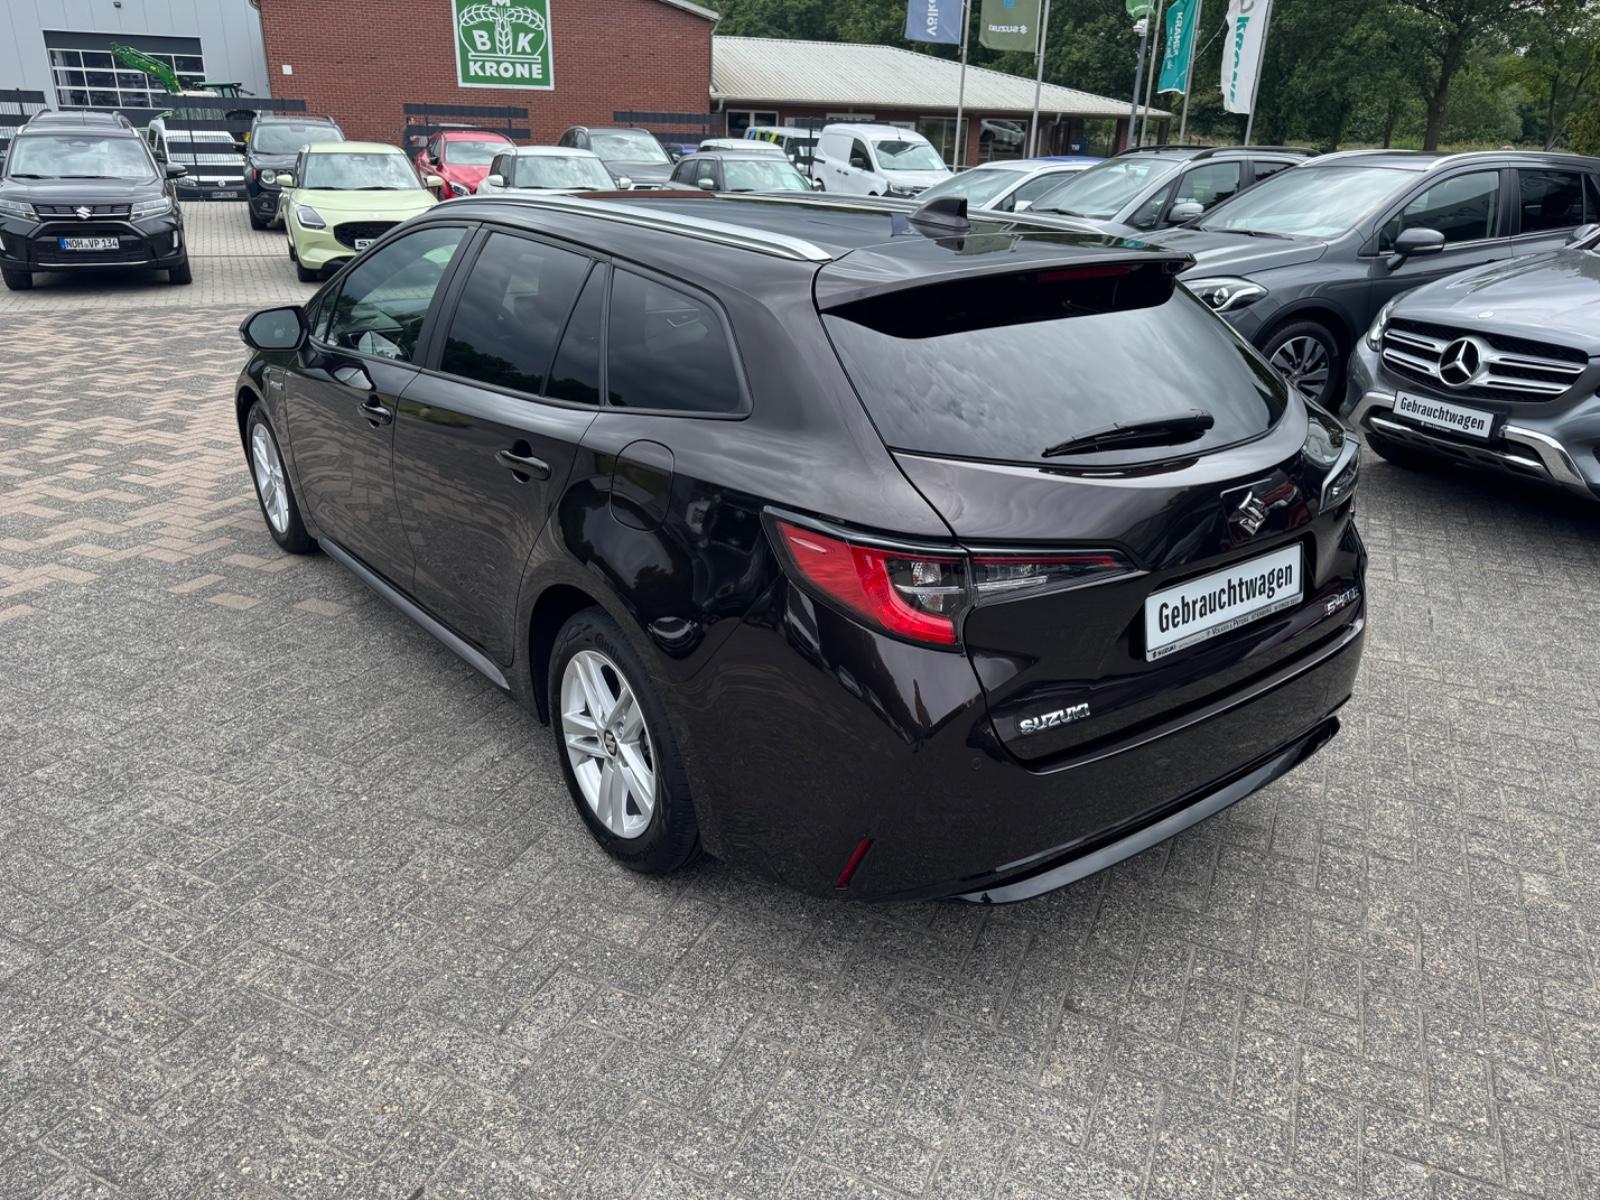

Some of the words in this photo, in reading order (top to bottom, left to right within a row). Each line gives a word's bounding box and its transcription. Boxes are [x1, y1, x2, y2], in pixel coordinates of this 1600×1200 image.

[472, 30, 491, 51] B
[516, 33, 535, 53] K
[469, 61, 543, 79] KRONE
[65, 239, 83, 248] NOH
[89, 239, 100, 248] VP
[101, 239, 118, 248] 134
[1400, 396, 1485, 430] Gebrauchtwagen
[1158, 562, 1294, 633] Gebrauchtwagen
[1020, 702, 1091, 736] SUZUKI
